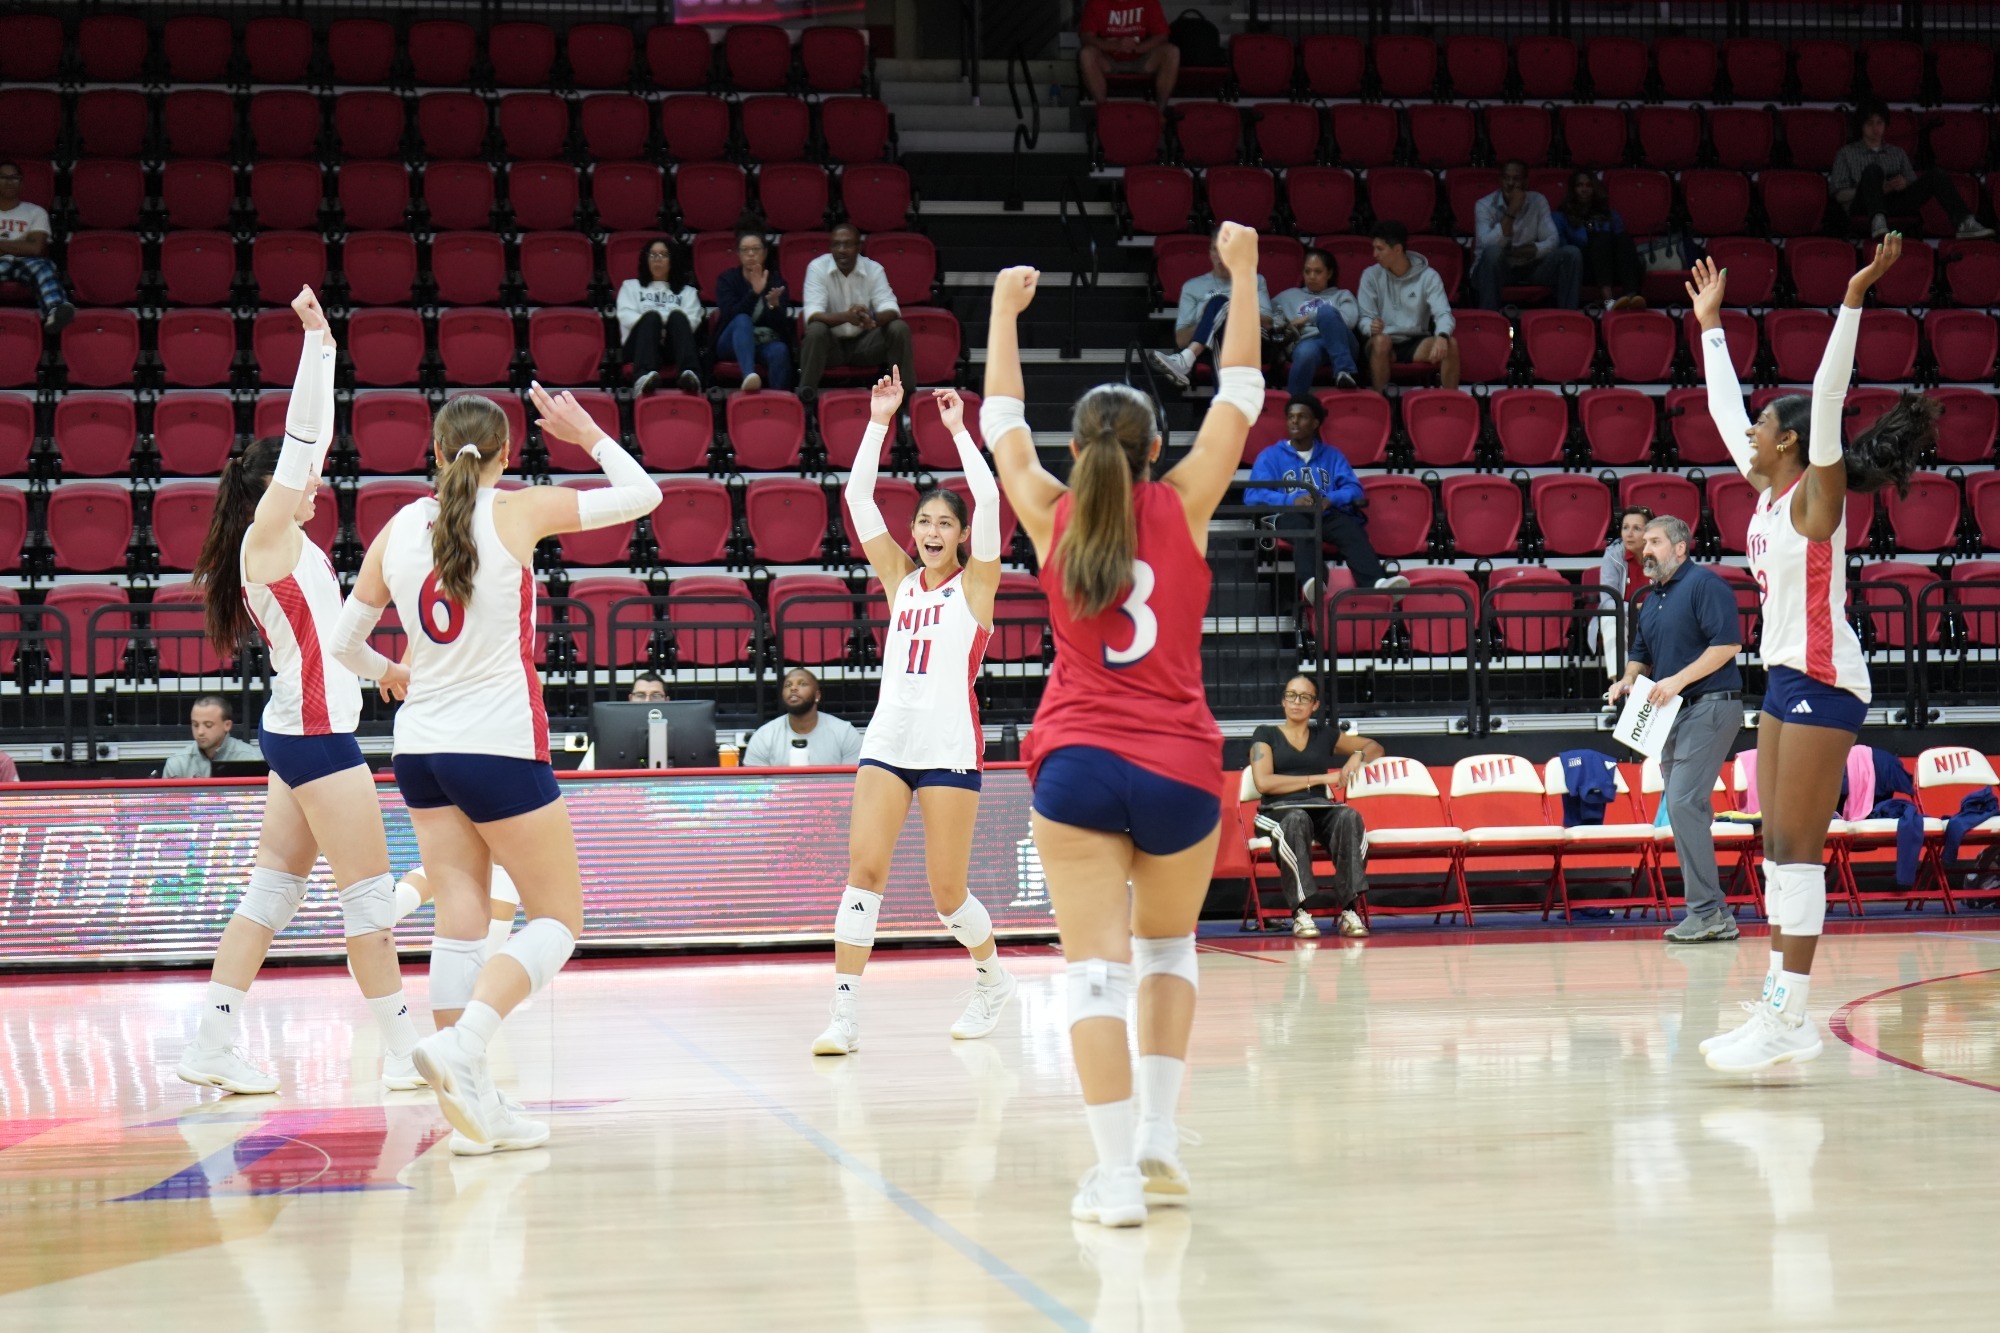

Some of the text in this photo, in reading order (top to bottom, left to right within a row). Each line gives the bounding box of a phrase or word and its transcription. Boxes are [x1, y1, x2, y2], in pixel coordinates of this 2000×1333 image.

[1109, 7, 1144, 26] NJIT
[639, 291, 682, 307] LONDON
[1283, 467, 1330, 495] GAP
[418, 563, 466, 645] 6
[1103, 558, 1158, 669] 3
[897, 603, 945, 635] NJIT
[906, 639, 932, 674] 11
[1364, 759, 1410, 787] NJIT
[1470, 756, 1516, 786] NJIT
[1934, 750, 1971, 775] NJIT
